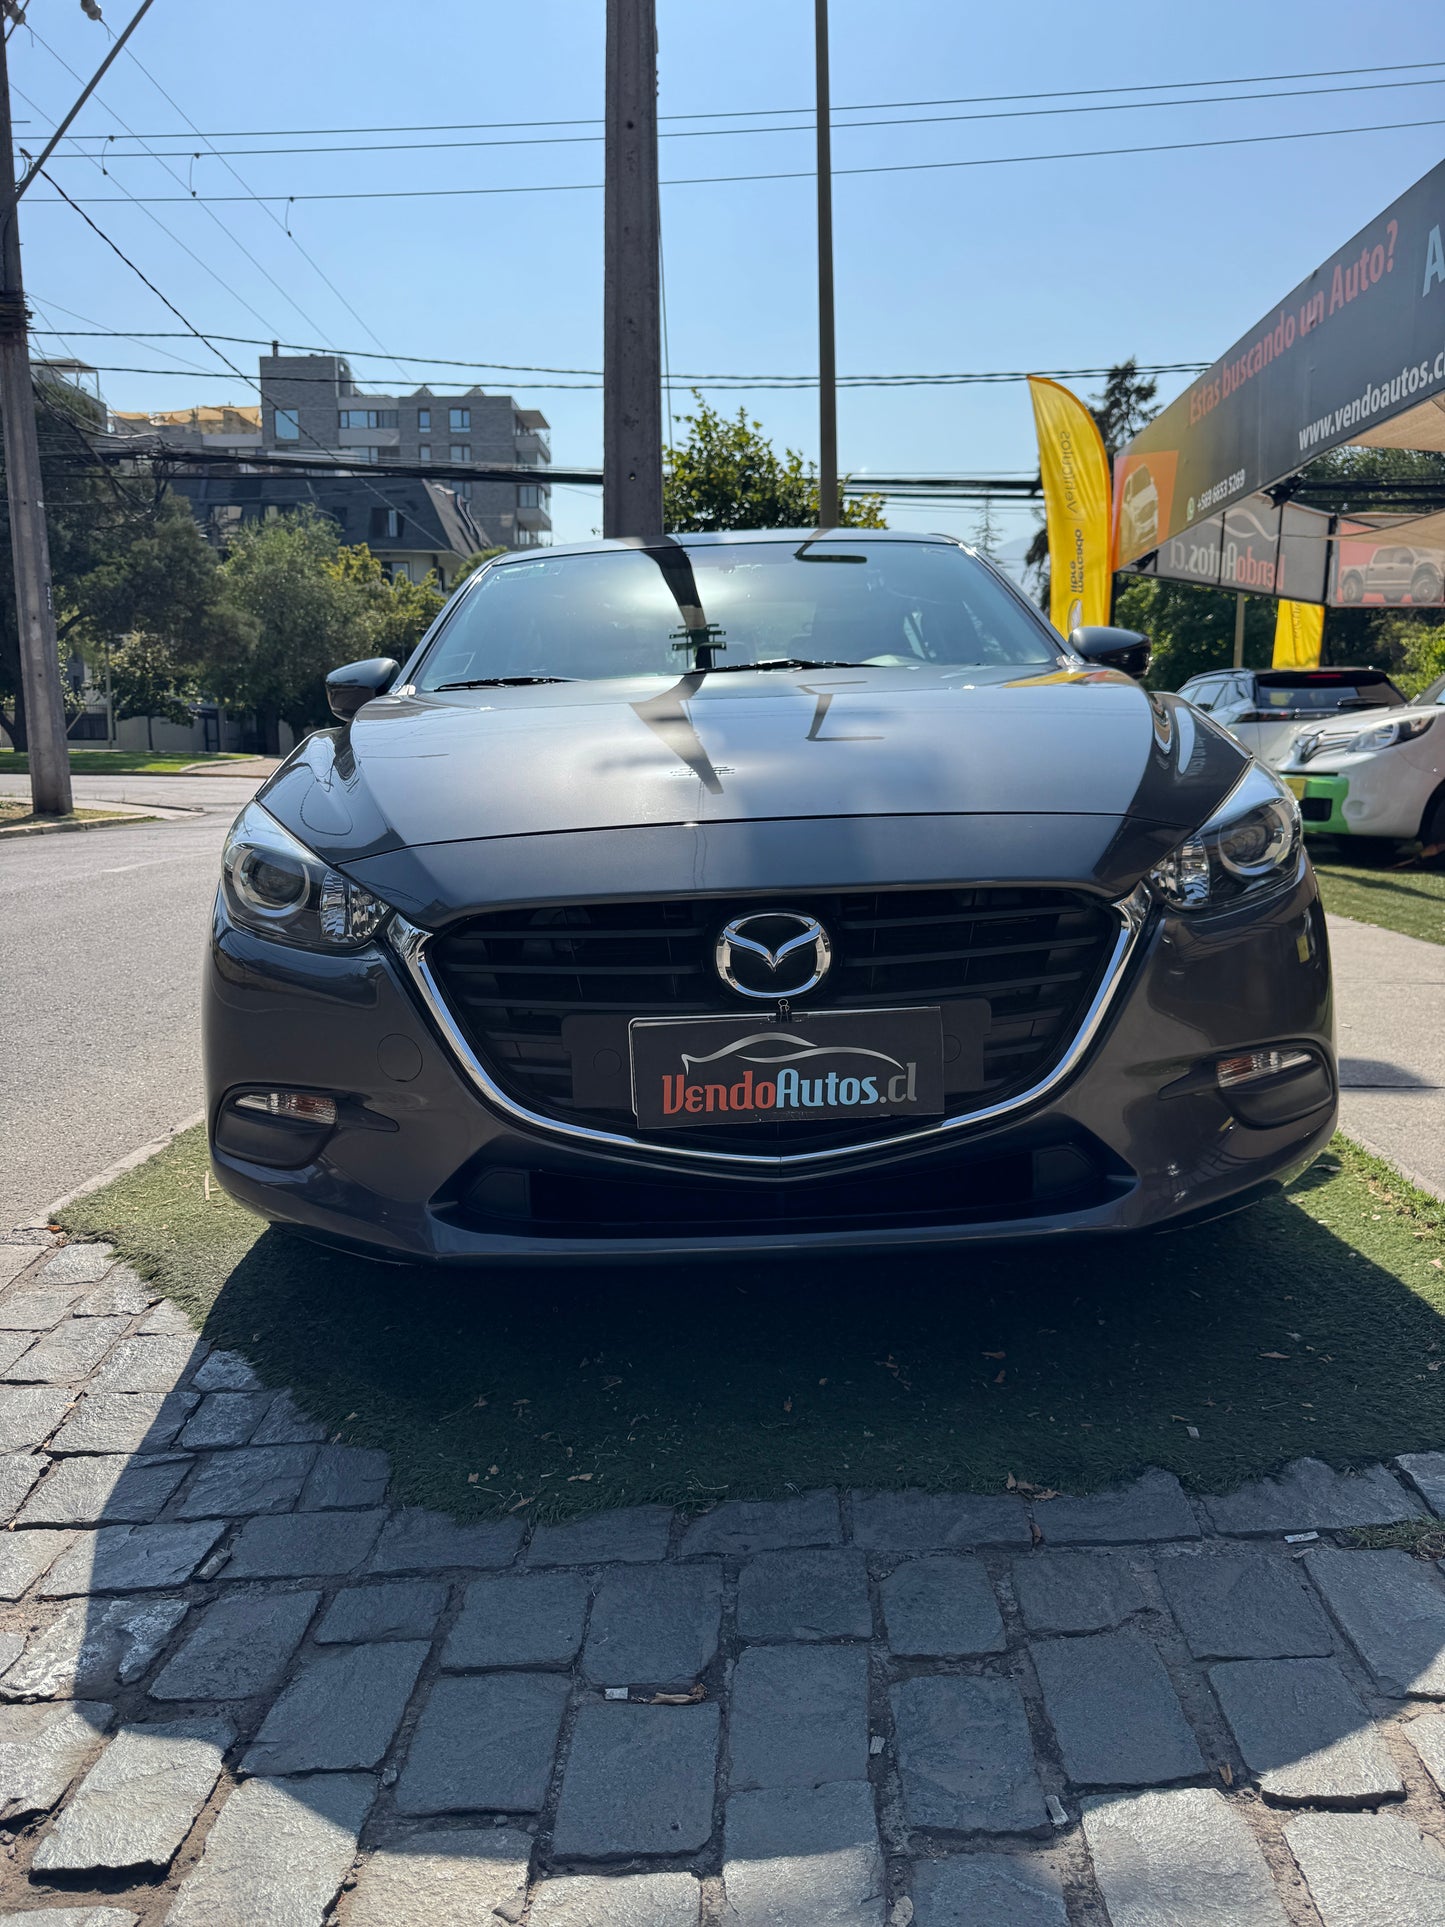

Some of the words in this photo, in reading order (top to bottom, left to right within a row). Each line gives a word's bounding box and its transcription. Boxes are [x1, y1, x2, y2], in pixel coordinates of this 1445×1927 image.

[1221, 309, 1296, 400] buscando
[1299, 289, 1325, 338] un
[1328, 218, 1399, 317] Auto?
[1299, 345, 1445, 451] www.vendoautos.c
[662, 1062, 918, 1115] VendoAutos.cl
